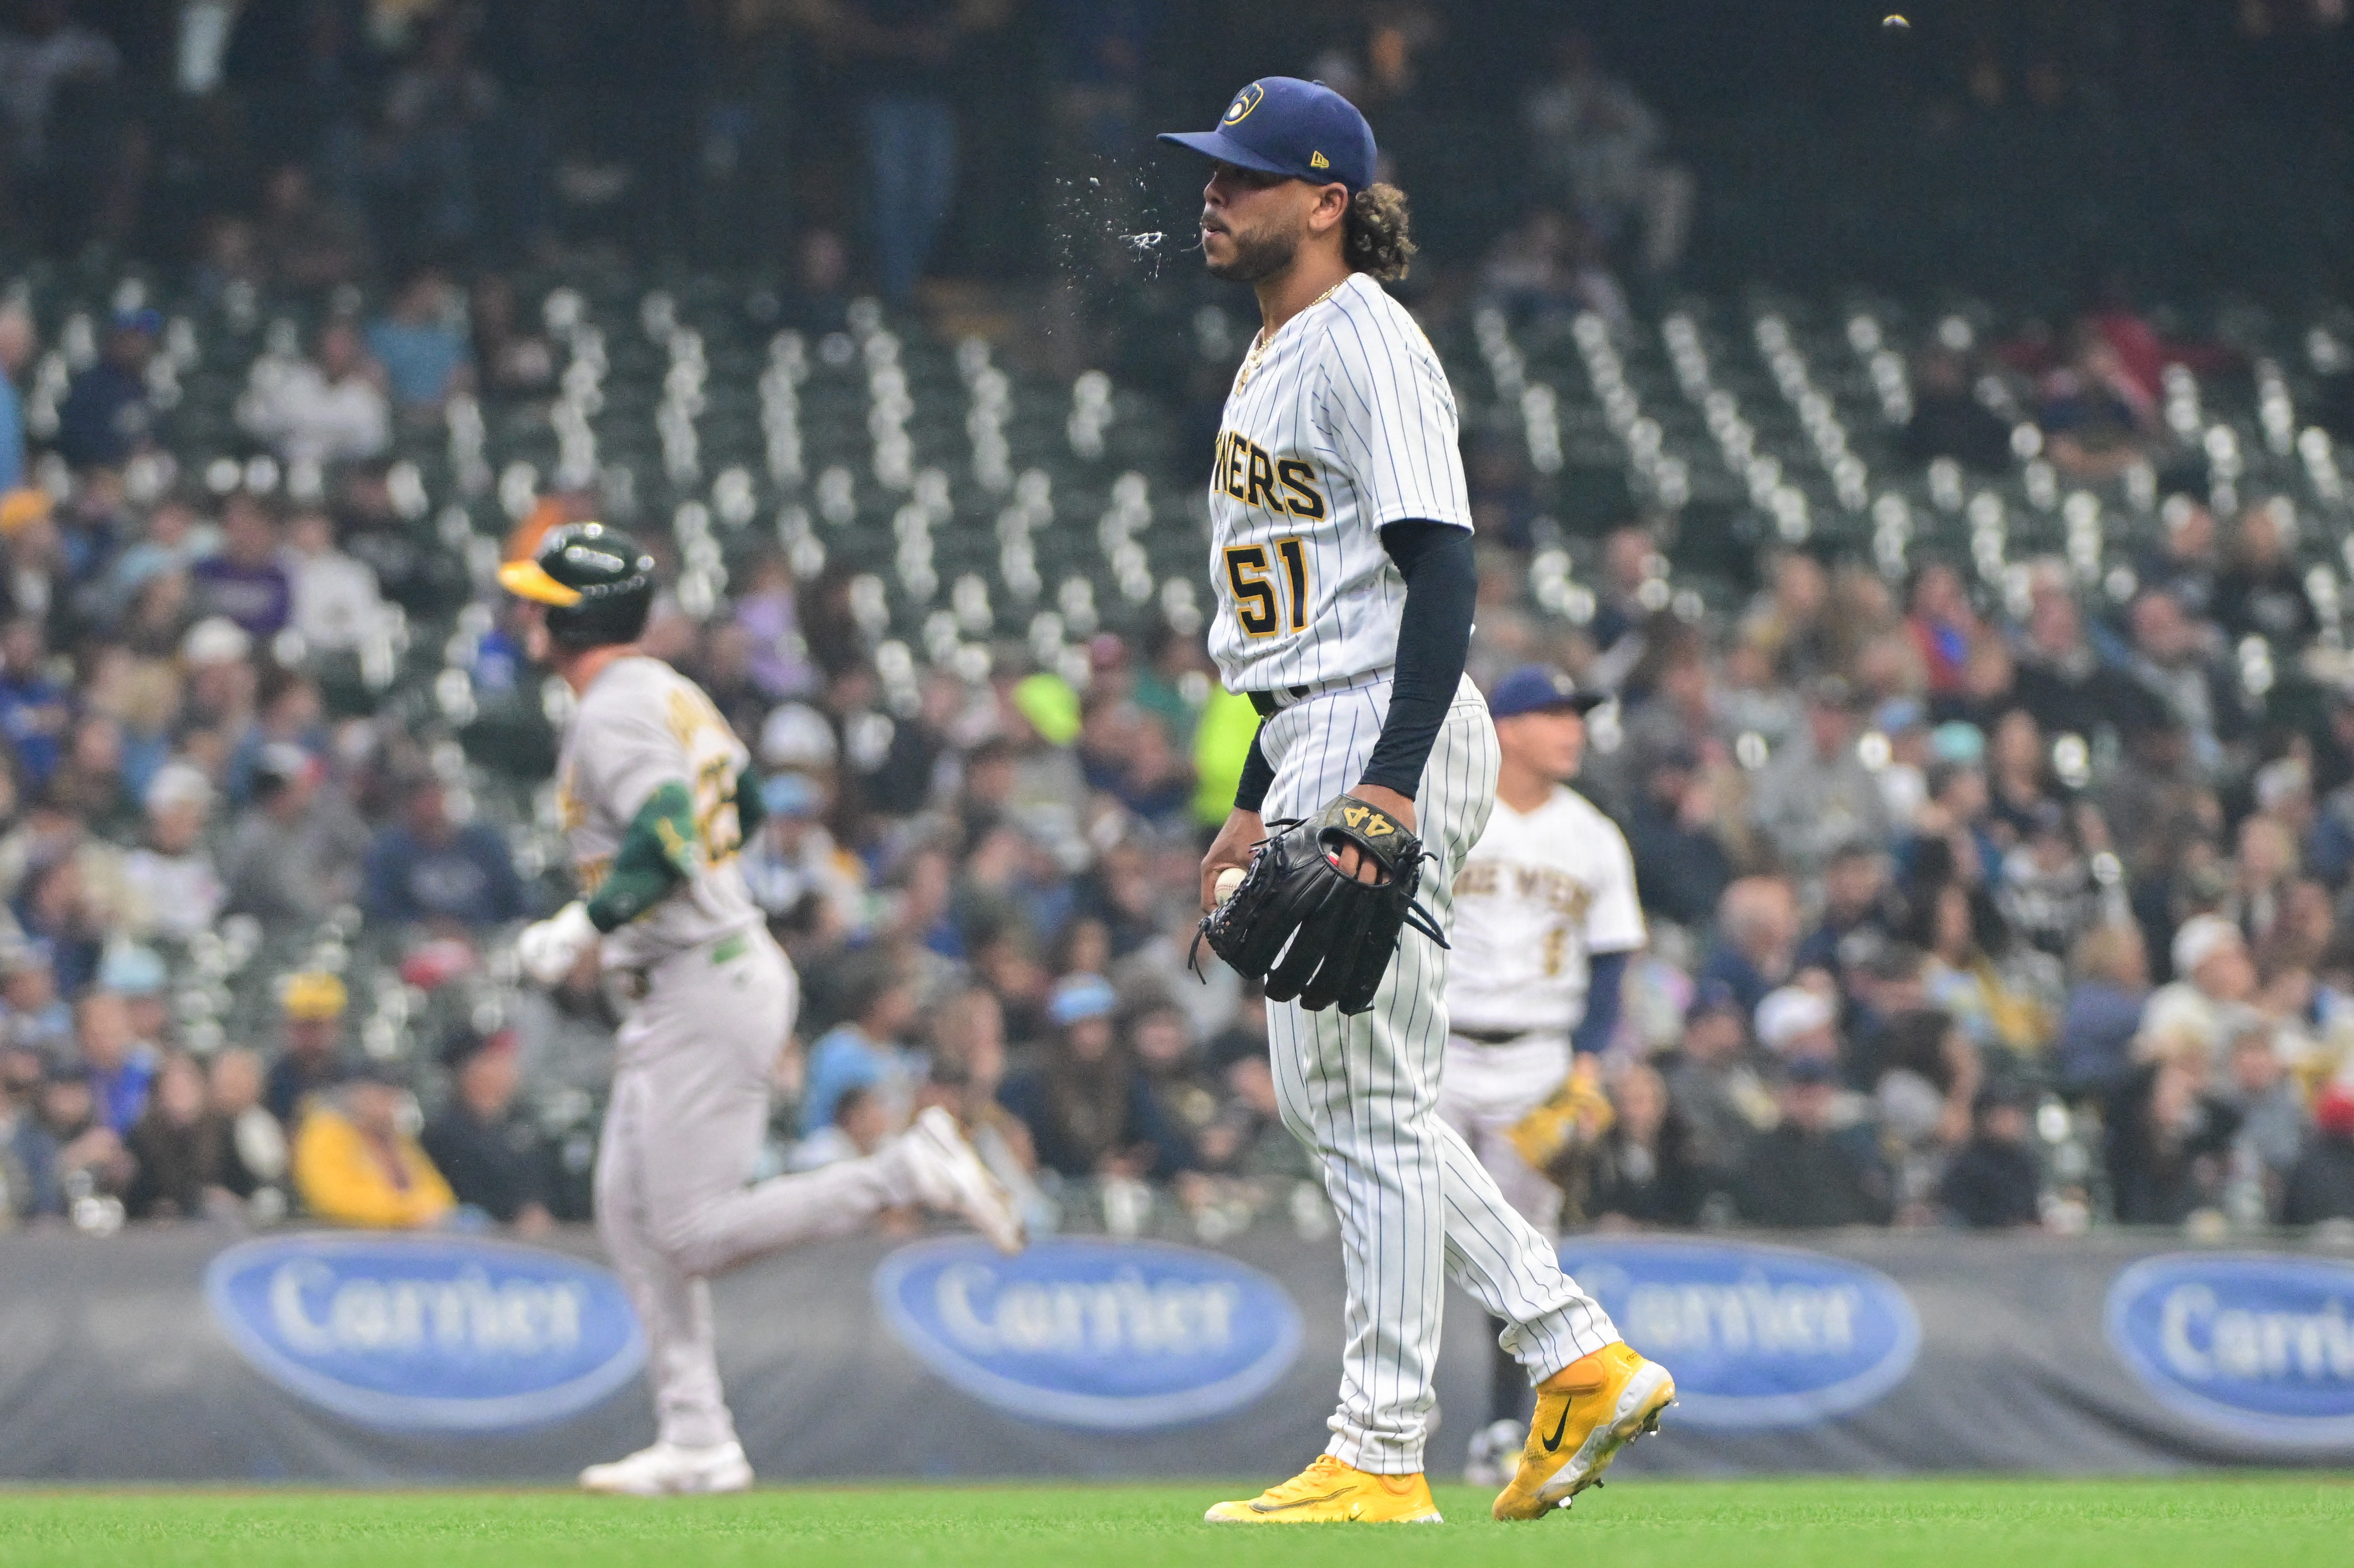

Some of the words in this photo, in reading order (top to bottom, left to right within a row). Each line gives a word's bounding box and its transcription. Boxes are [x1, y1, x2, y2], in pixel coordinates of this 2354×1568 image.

[1223, 536, 1308, 637] 51
[269, 1257, 586, 1355] Carrier
[934, 1260, 1239, 1355] Carrier
